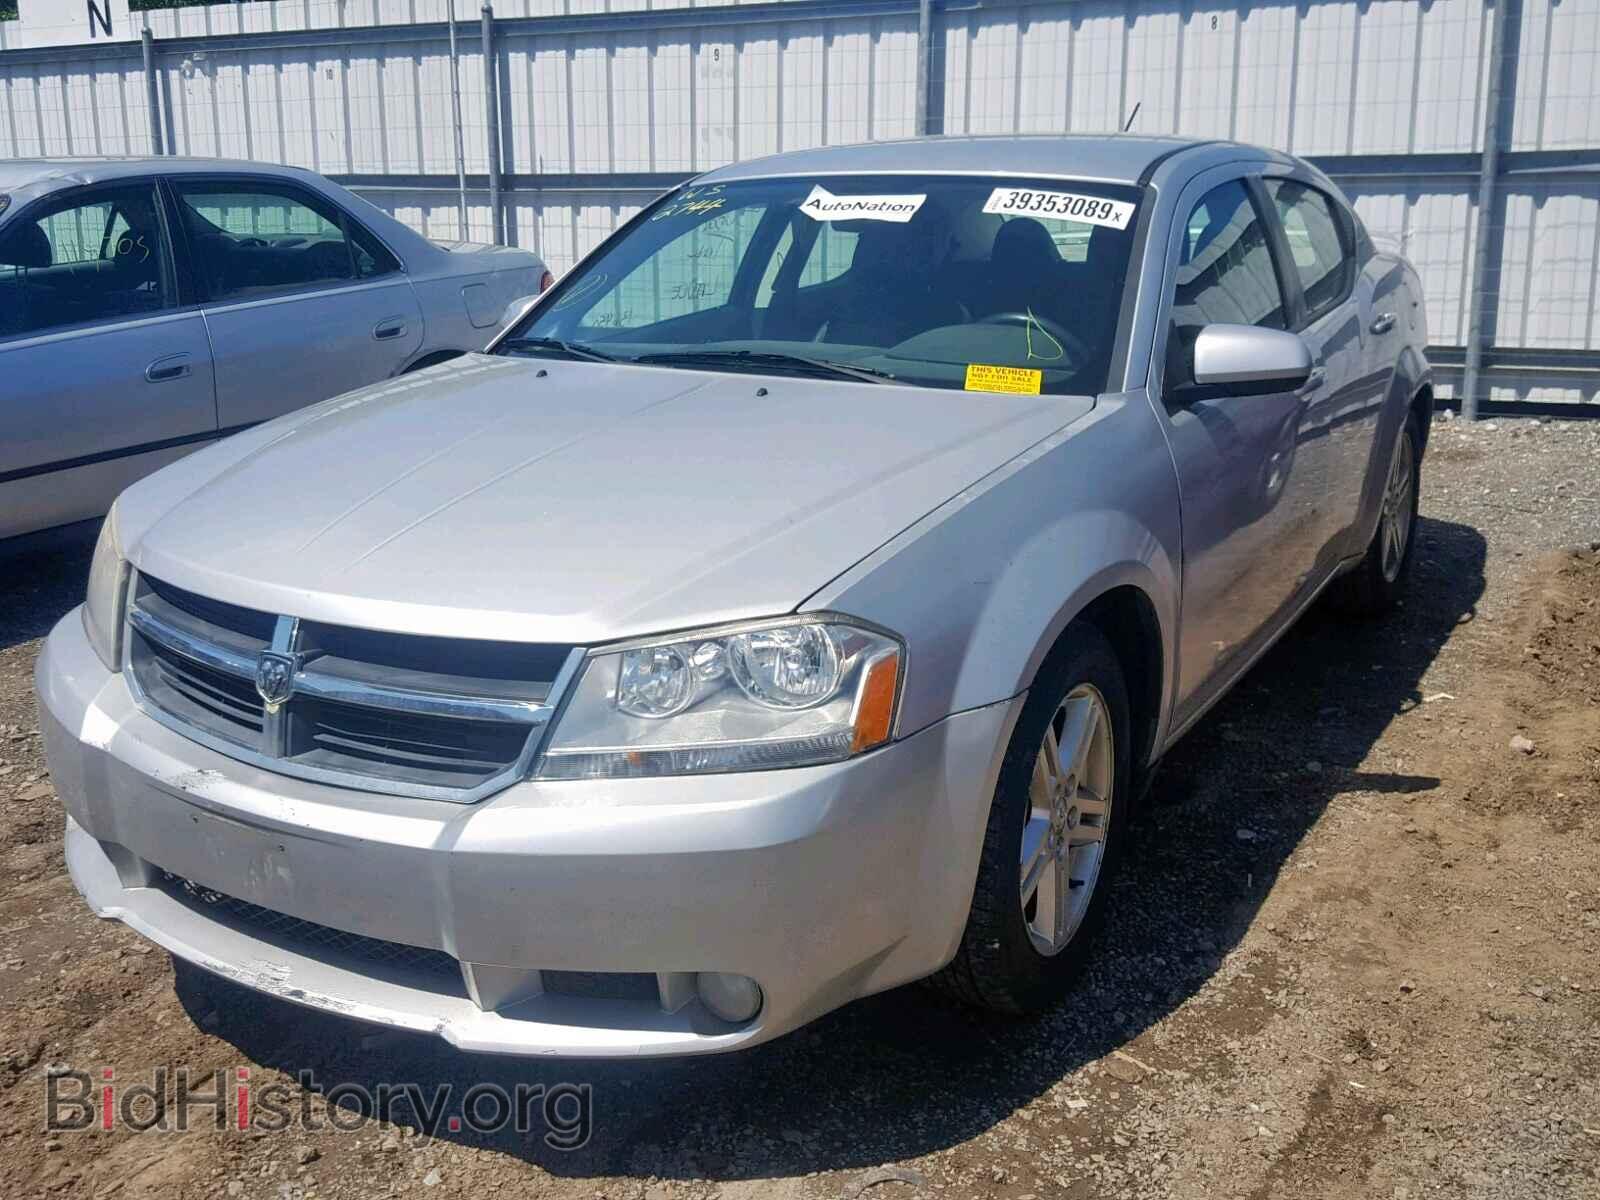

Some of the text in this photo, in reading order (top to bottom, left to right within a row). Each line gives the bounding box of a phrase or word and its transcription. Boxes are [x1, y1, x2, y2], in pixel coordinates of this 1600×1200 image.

[86, 0, 113, 38] N
[1211, 15, 1218, 30] 8
[806, 198, 916, 212] AutoNation
[1002, 191, 1114, 220] 39353089
[971, 366, 1034, 377] THIS VEHICLE
[991, 374, 1009, 382] FOR
